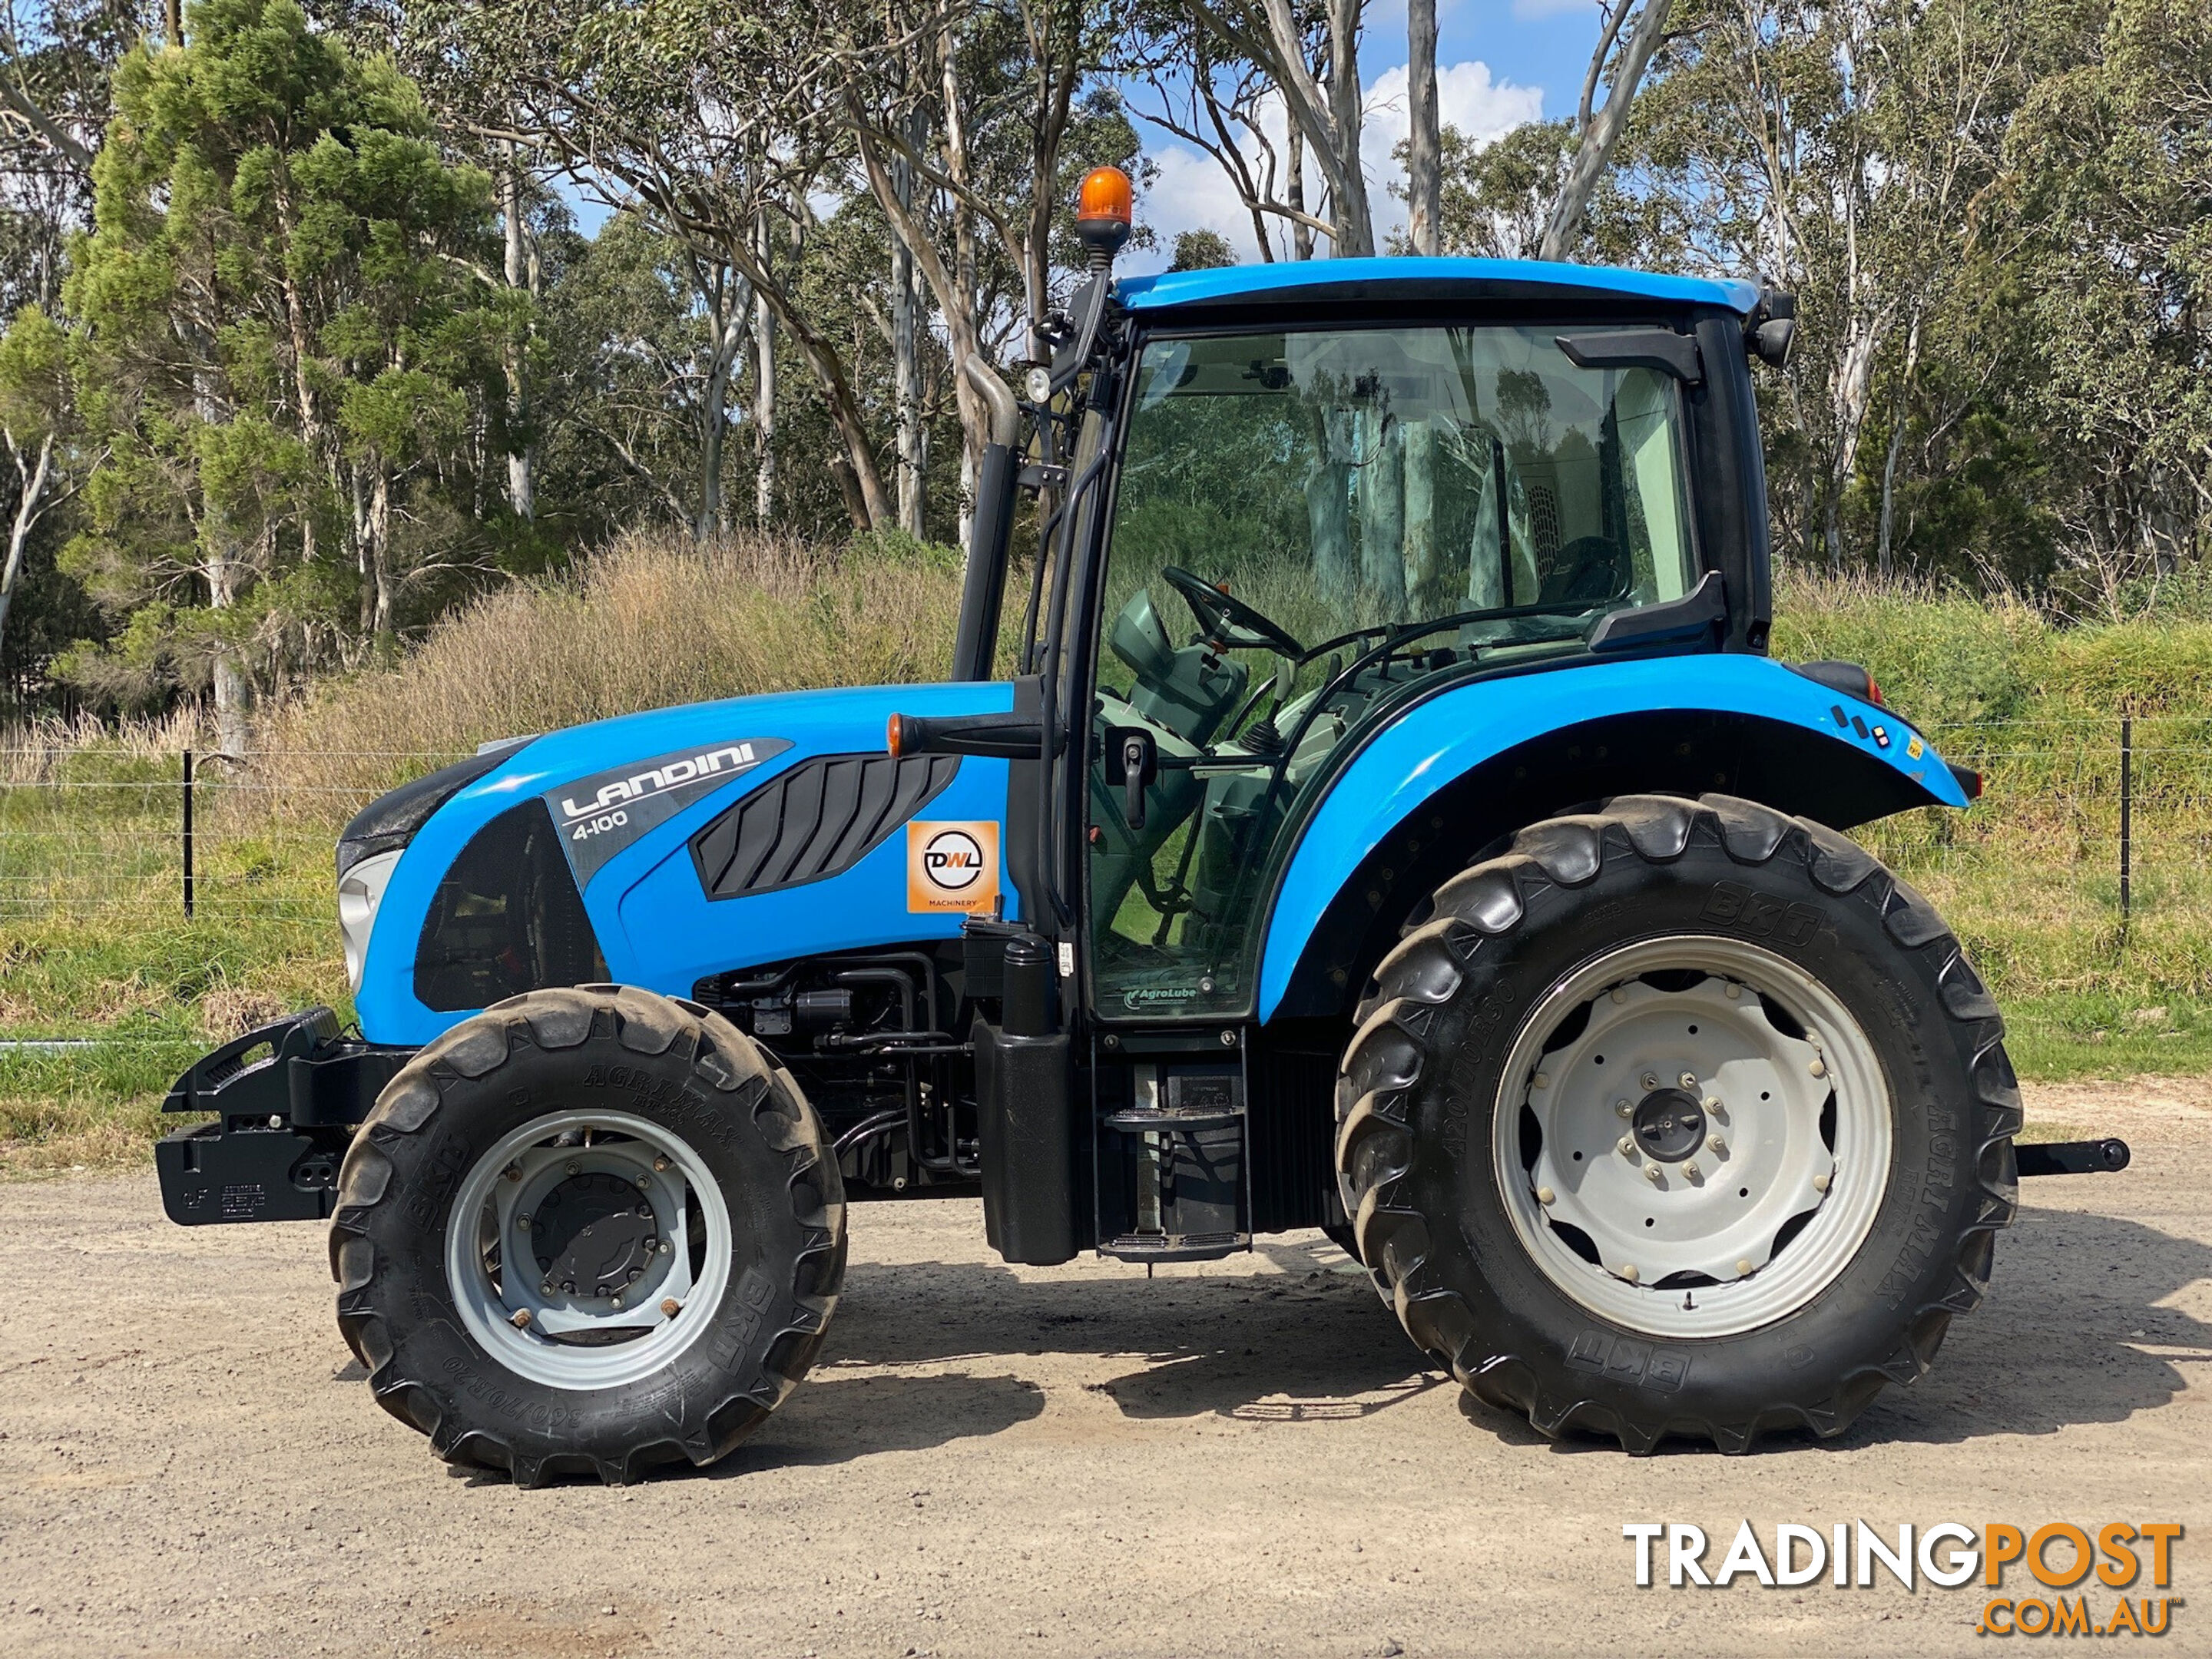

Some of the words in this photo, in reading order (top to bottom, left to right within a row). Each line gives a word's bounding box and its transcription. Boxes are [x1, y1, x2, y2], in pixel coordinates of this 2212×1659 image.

[561, 743, 755, 817] LANDINI
[572, 810, 628, 840] 4-100
[926, 853, 982, 868] DWL
[1700, 883, 1823, 944] BKT
[1139, 988, 1197, 1000] AgroLube
[708, 1269, 774, 1374] BKT
[1568, 1332, 1690, 1391] BKT
